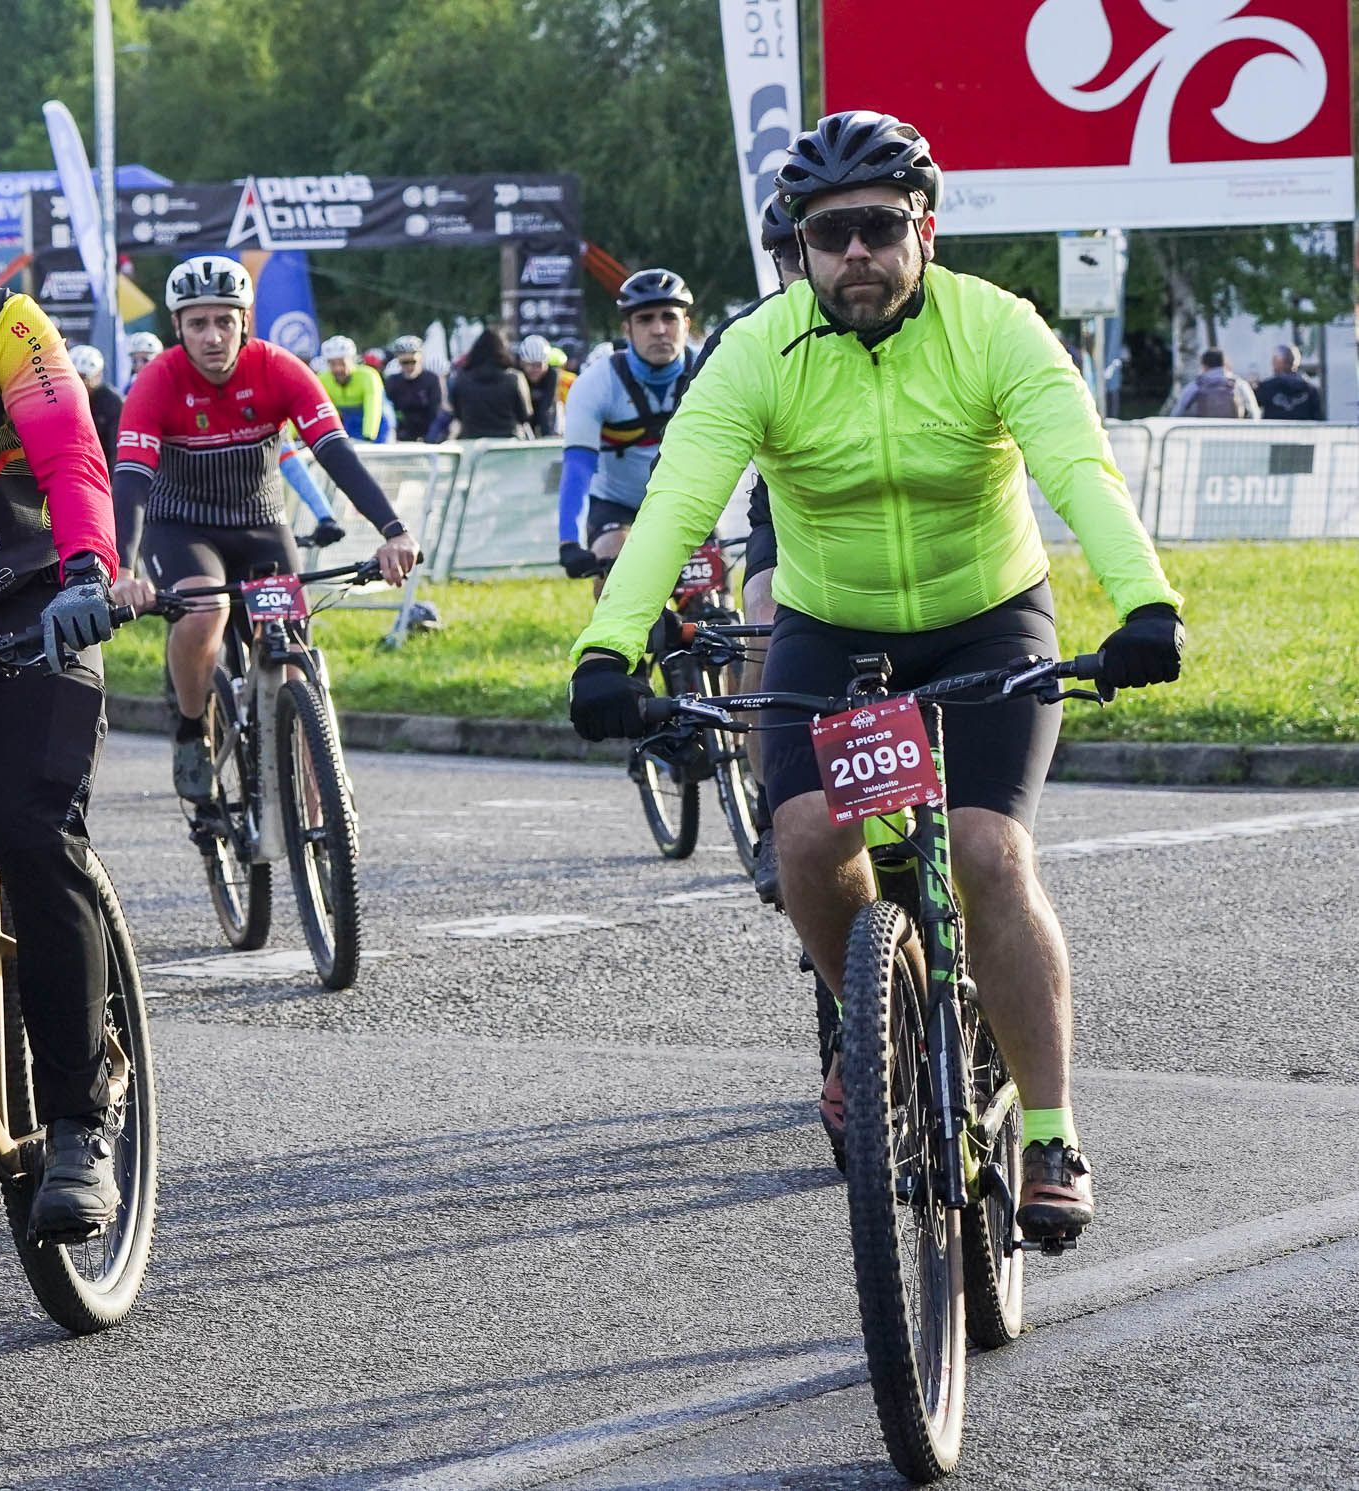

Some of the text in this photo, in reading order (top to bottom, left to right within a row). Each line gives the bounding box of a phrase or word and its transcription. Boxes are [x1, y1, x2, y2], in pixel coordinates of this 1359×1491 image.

[856, 656, 879, 664] GARMIN
[730, 697, 775, 705] RITCHEY
[845, 730, 893, 749] 2 PICOS
[830, 740, 920, 788] 2099
